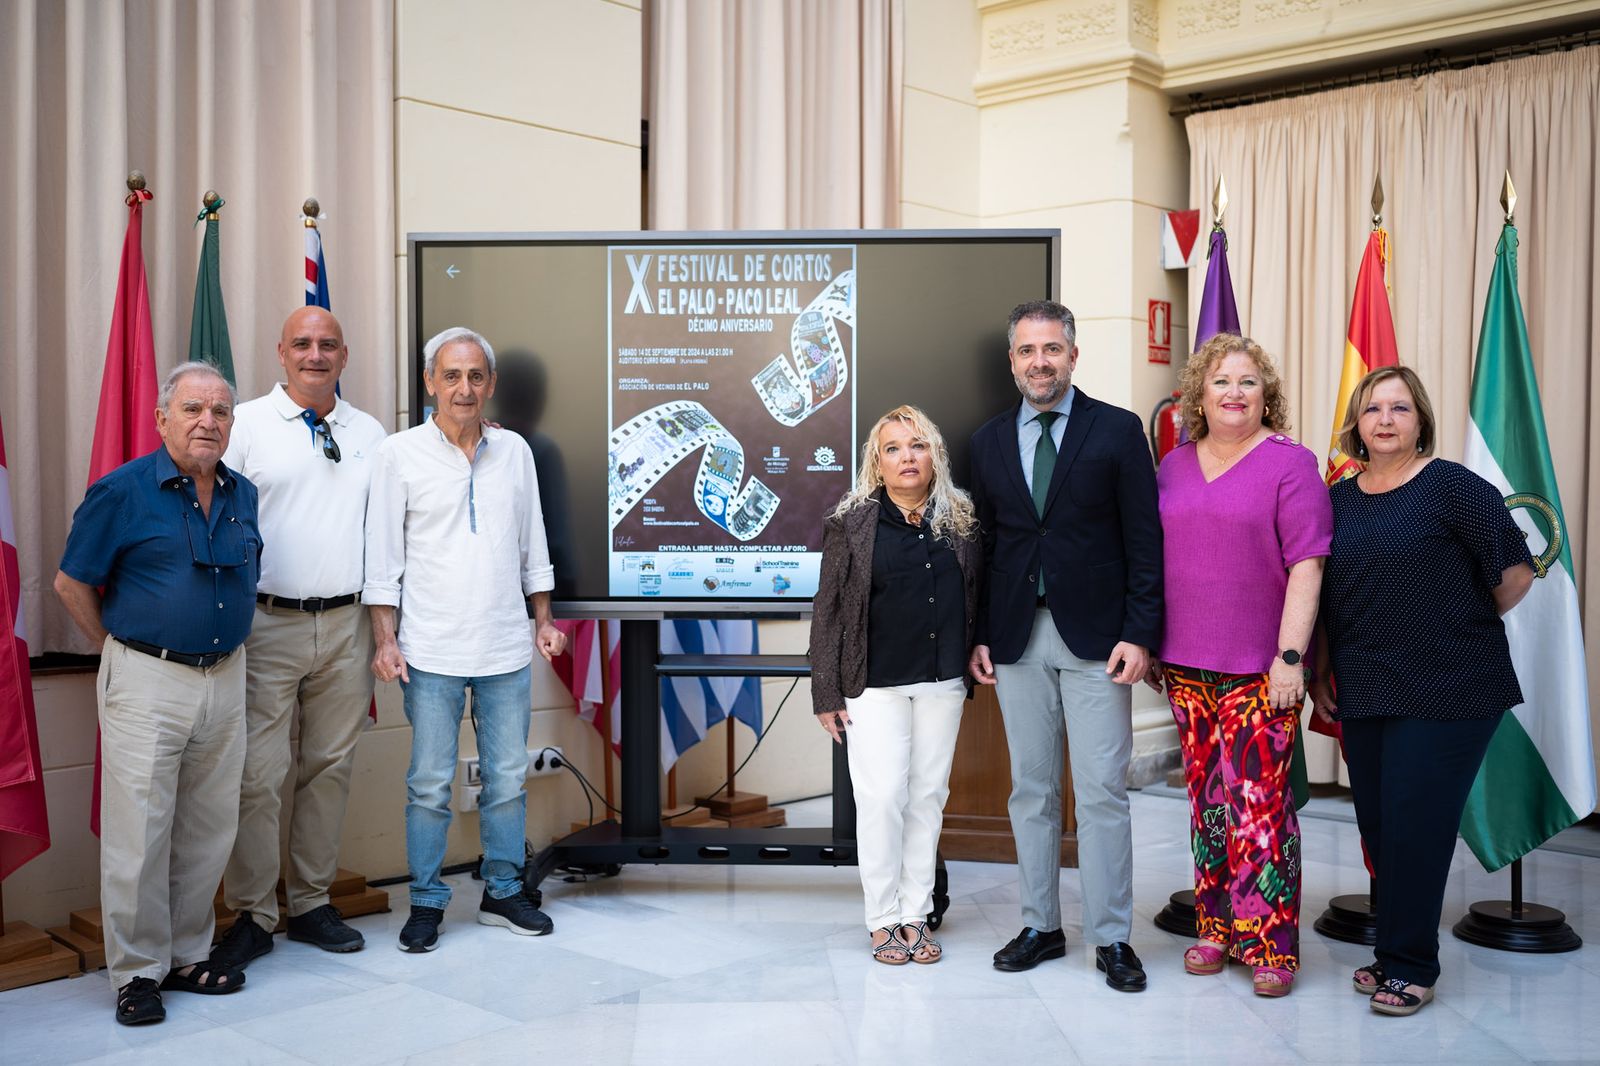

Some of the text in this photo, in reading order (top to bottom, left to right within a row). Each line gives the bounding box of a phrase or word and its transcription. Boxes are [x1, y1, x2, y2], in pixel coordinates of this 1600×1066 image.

[657, 254, 832, 282] FESTIVAL DE CORTOS
[624, 254, 655, 314] X
[658, 288, 677, 314] EL
[679, 288, 715, 314] PALO
[726, 288, 764, 314] PACO
[766, 288, 802, 314] LEAL
[688, 318, 773, 332] DÉCIMO ANIVERSARIO
[645, 348, 651, 356] DE
[652, 348, 680, 356] SEPTIEMBRE
[681, 348, 687, 356] DE
[705, 348, 715, 356] LAS
